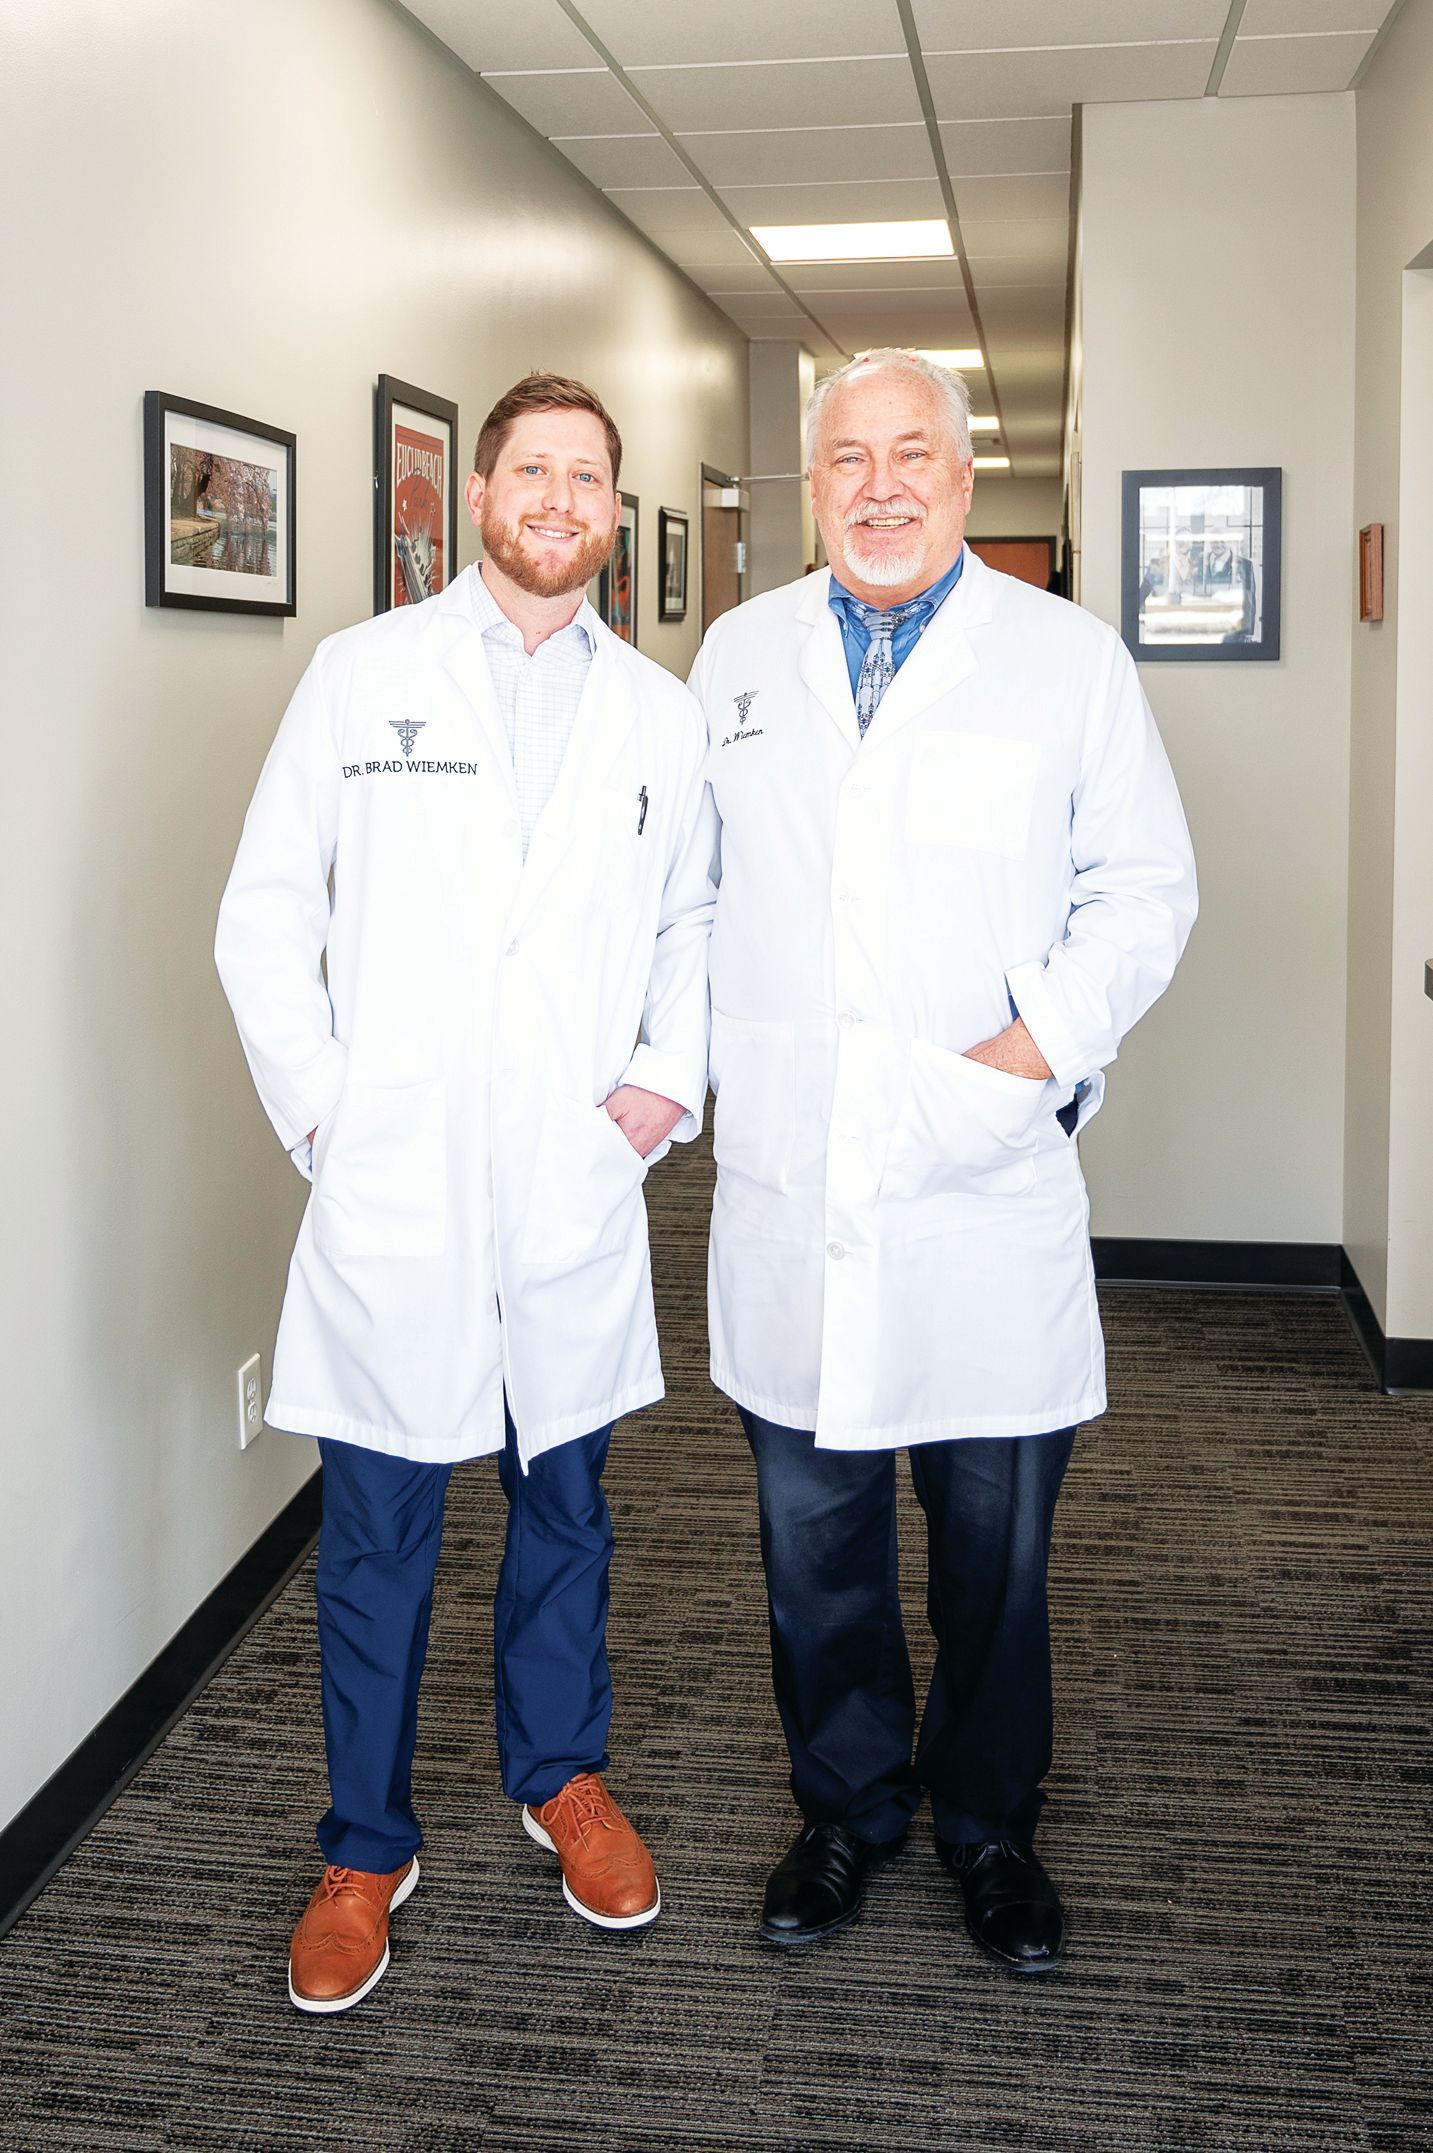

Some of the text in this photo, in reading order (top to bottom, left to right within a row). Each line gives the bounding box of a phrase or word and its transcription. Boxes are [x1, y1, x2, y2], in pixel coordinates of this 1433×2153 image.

[422, 449, 442, 498] BEACH
[342, 760, 477, 778] DR. BRAD WIEMKEN
